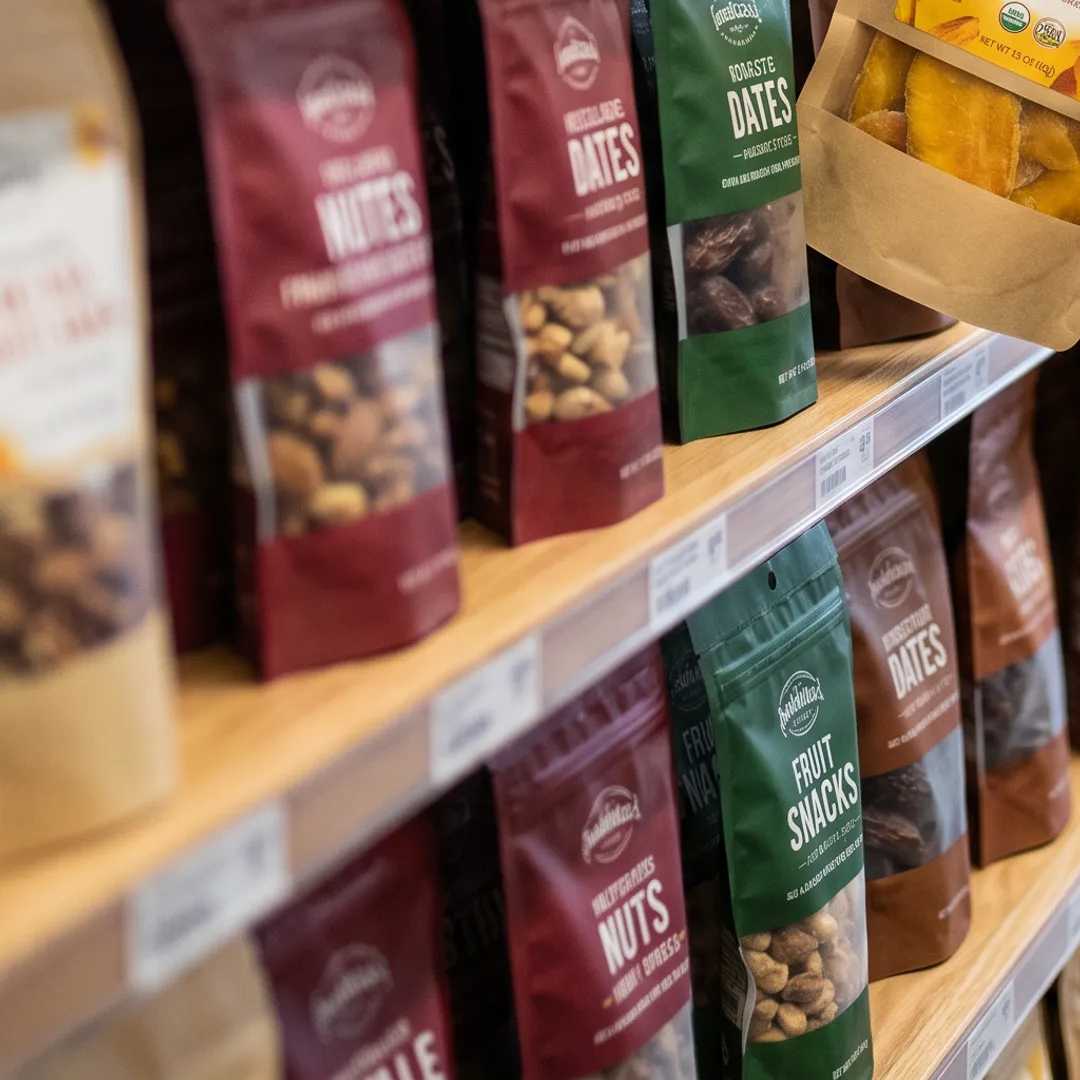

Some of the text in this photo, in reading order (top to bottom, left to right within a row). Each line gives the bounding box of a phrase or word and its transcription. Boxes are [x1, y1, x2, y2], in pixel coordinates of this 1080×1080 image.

[997, 43, 1011, 55] WT
[727, 77, 792, 140] DATES
[568, 123, 640, 197] DATES
[888, 622, 948, 700] DATES
[791, 733, 834, 794] FRUIT
[787, 762, 858, 852] SNACKS
[598, 879, 669, 976] NUTS
